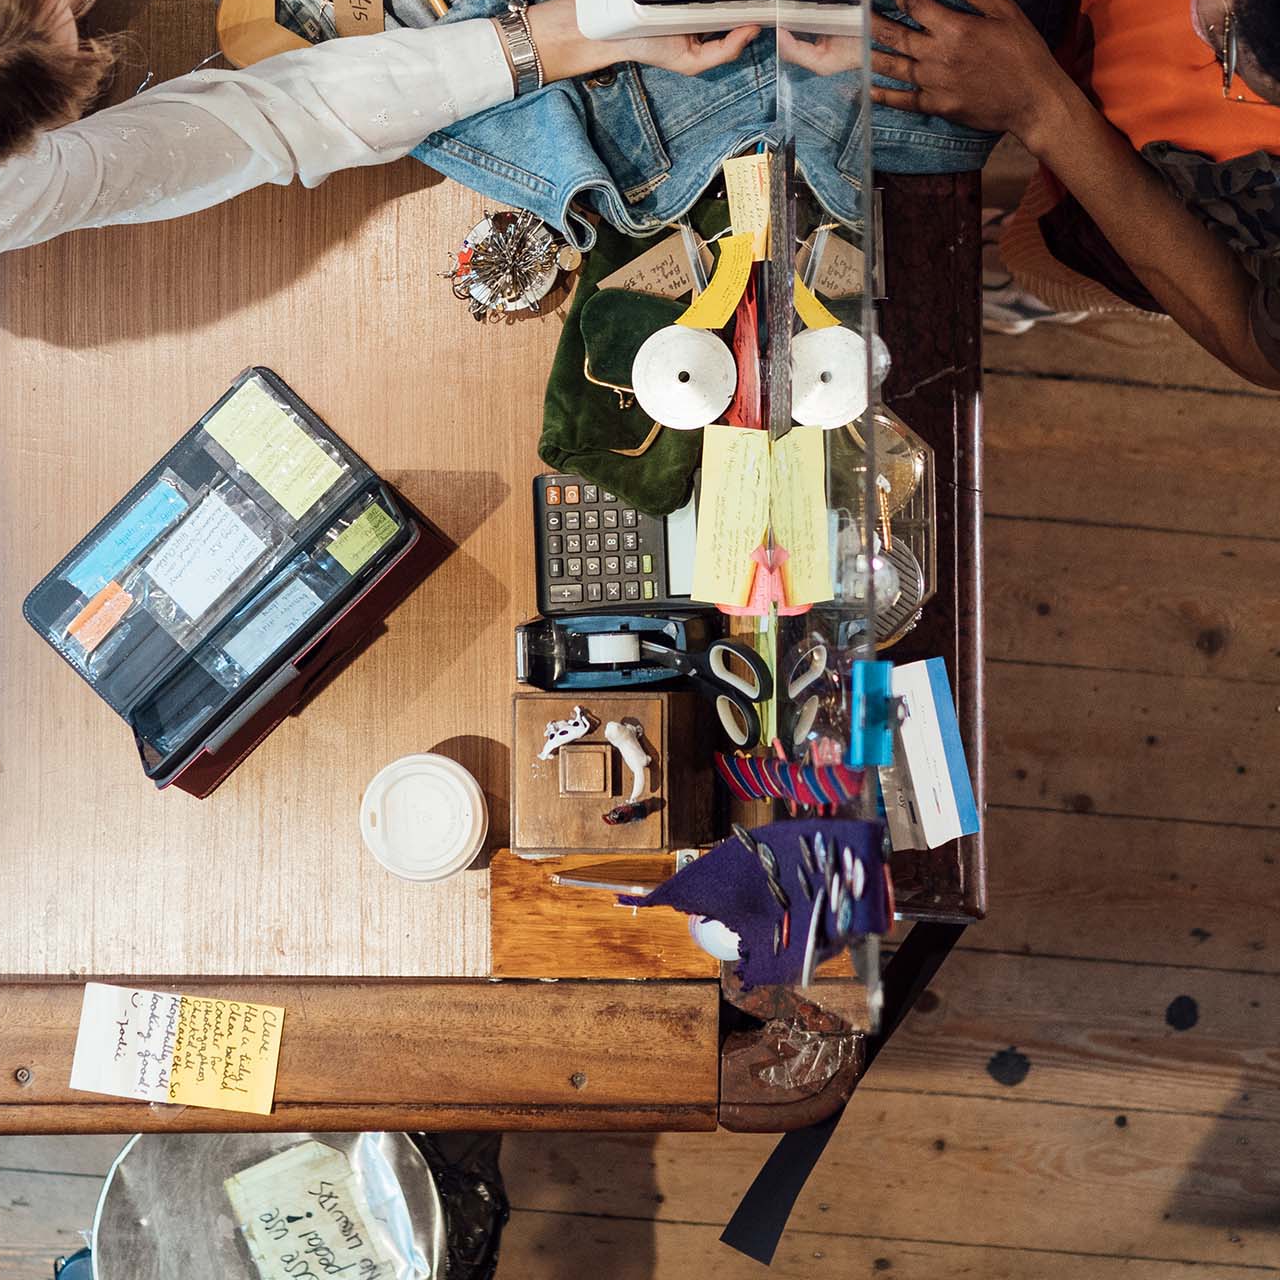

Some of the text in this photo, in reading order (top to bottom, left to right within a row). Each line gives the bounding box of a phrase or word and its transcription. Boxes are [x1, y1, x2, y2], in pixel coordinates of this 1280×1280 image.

[548, 491, 558, 502] AC
[568, 490, 576, 499] C
[242, 1005, 258, 1032] Had
[259, 1208, 289, 1240] use
